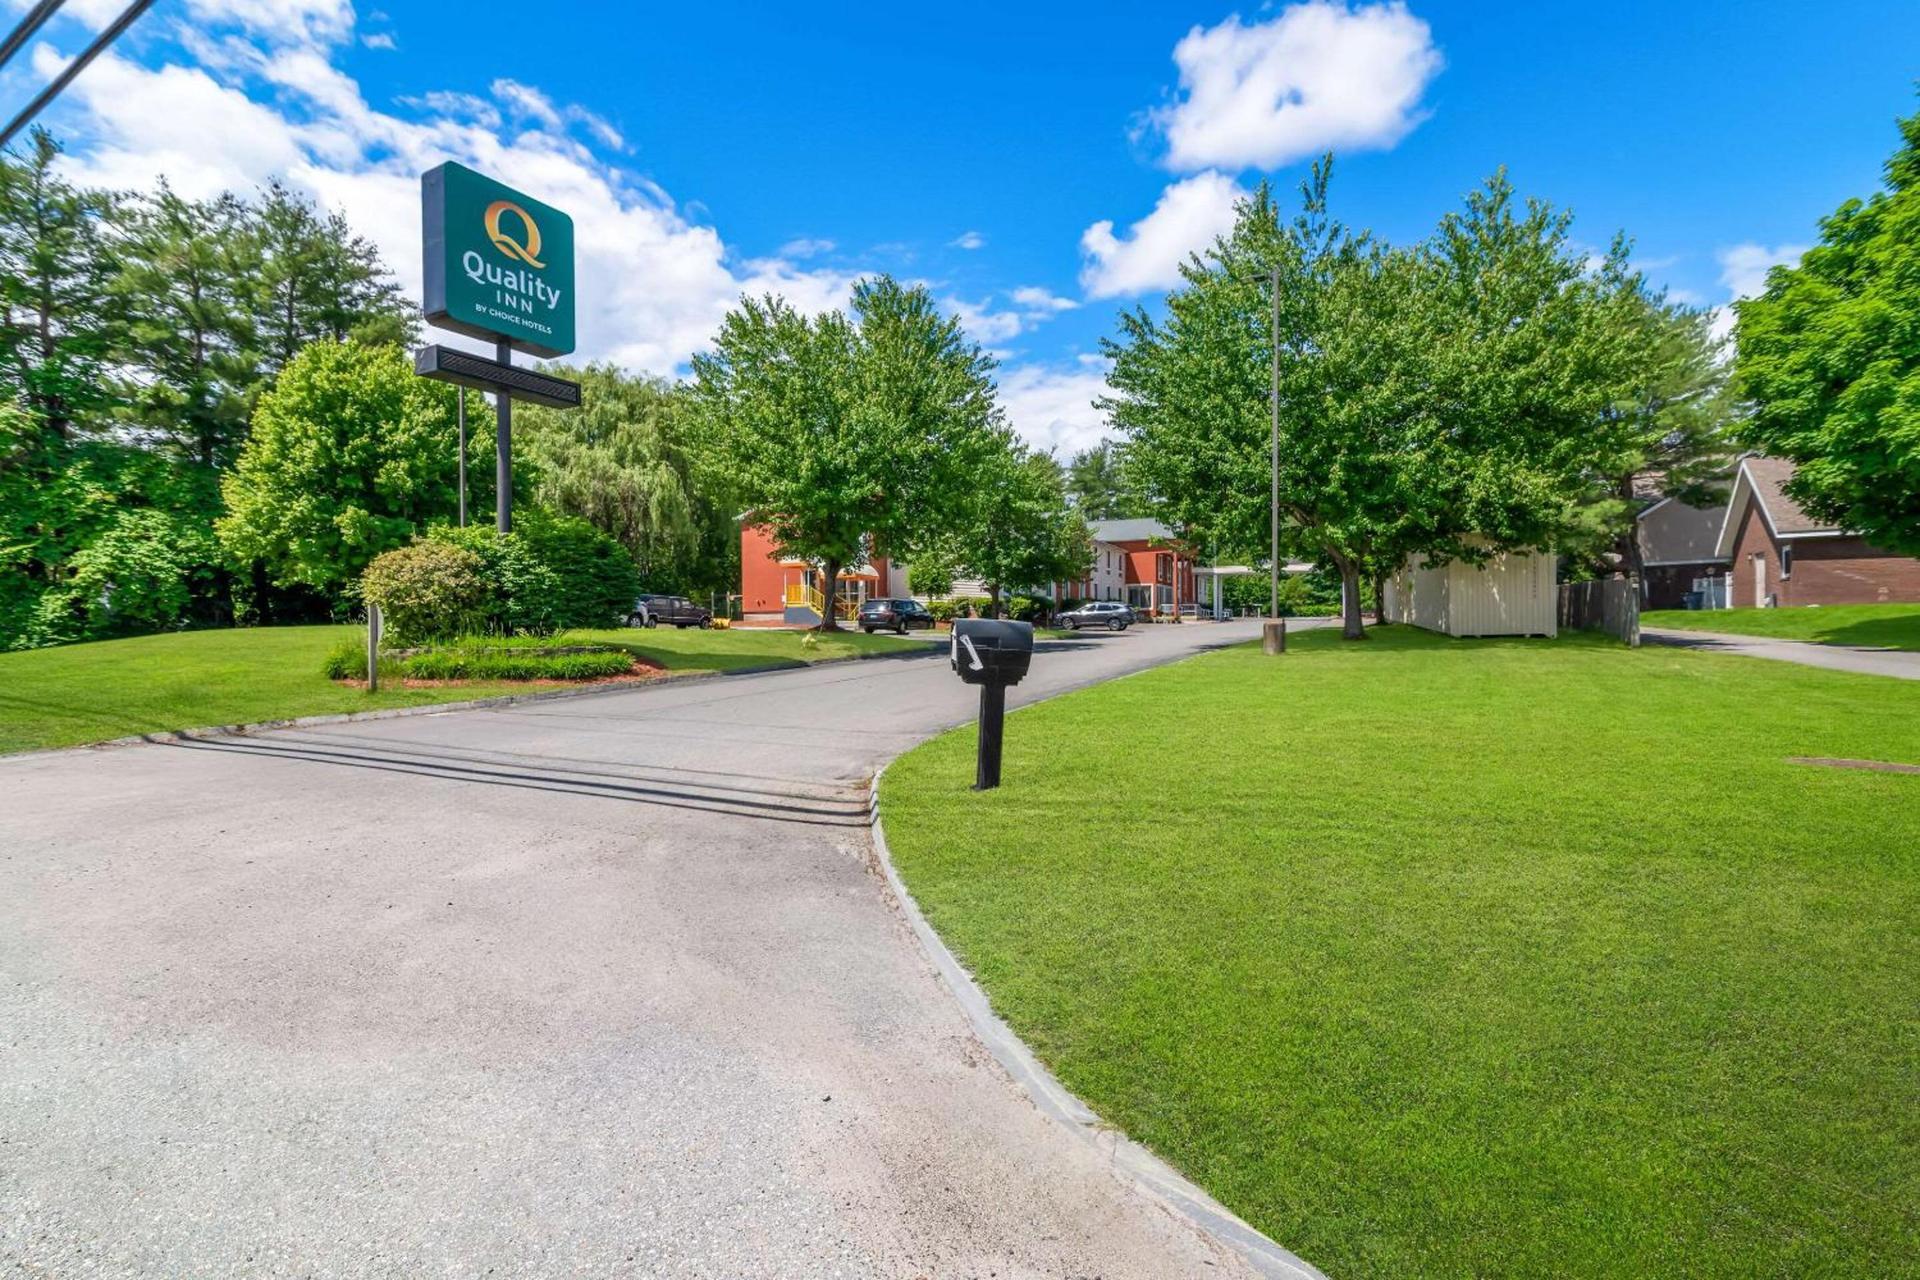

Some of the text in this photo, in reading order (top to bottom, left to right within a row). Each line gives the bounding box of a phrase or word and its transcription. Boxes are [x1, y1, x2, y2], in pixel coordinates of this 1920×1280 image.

[484, 200, 546, 269] Q
[462, 250, 561, 309] Quality
[496, 289, 533, 314] INN
[475, 303, 552, 334] BY CHOICE HOTELS
